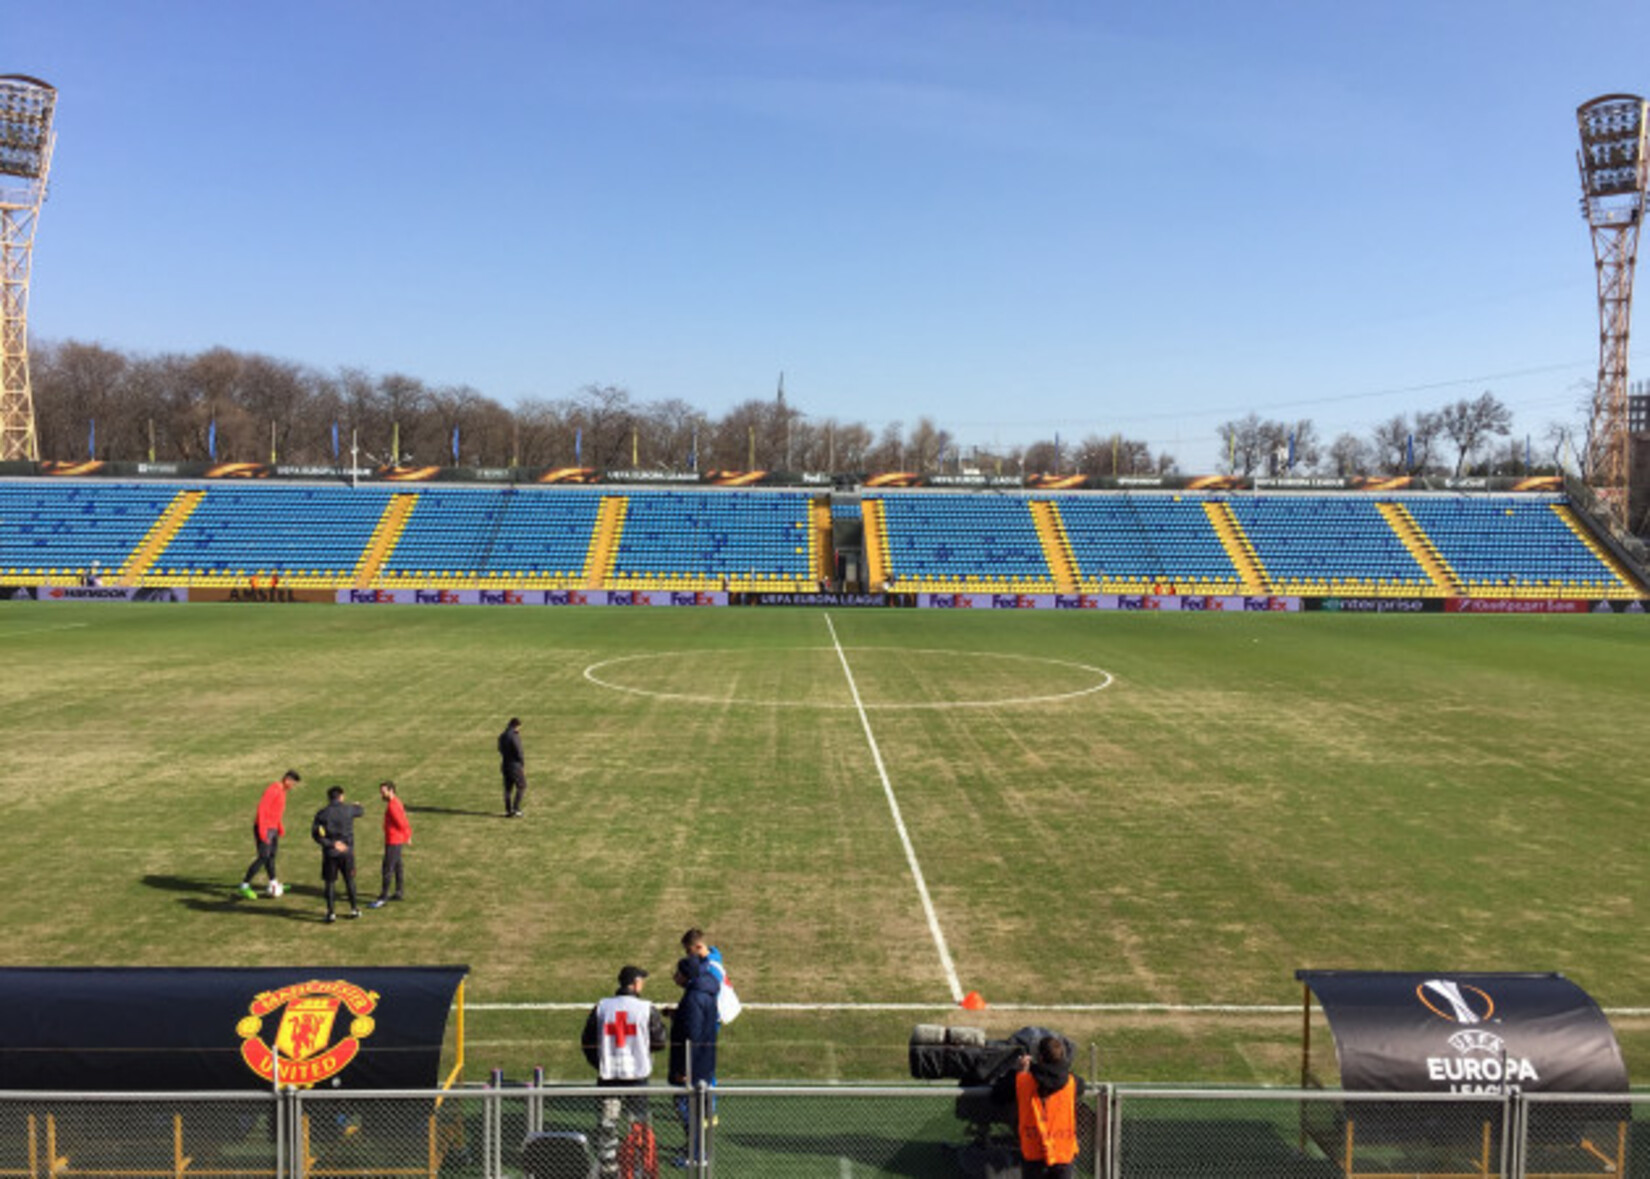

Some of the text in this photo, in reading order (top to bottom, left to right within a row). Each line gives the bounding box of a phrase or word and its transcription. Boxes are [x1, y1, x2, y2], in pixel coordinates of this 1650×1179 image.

[350, 589, 394, 602] FedEx
[415, 589, 459, 603] FedEx
[479, 589, 523, 604] FedEx
[544, 590, 587, 604] FedEx
[607, 591, 650, 605] FedEx
[670, 591, 713, 605] FedEx
[761, 594, 791, 604] UEFA
[793, 594, 838, 604] EUROPA
[929, 594, 972, 608] FedEx
[992, 594, 1035, 608] FedEx
[1055, 595, 1097, 609] FedEx
[1118, 596, 1160, 610] FedEx
[1180, 596, 1223, 610] FedEx
[1244, 597, 1286, 610] FedEx
[1451, 1033, 1501, 1051] UEFA
[259, 1055, 337, 1081] UNITED
[1426, 1057, 1540, 1081] EUROPA
